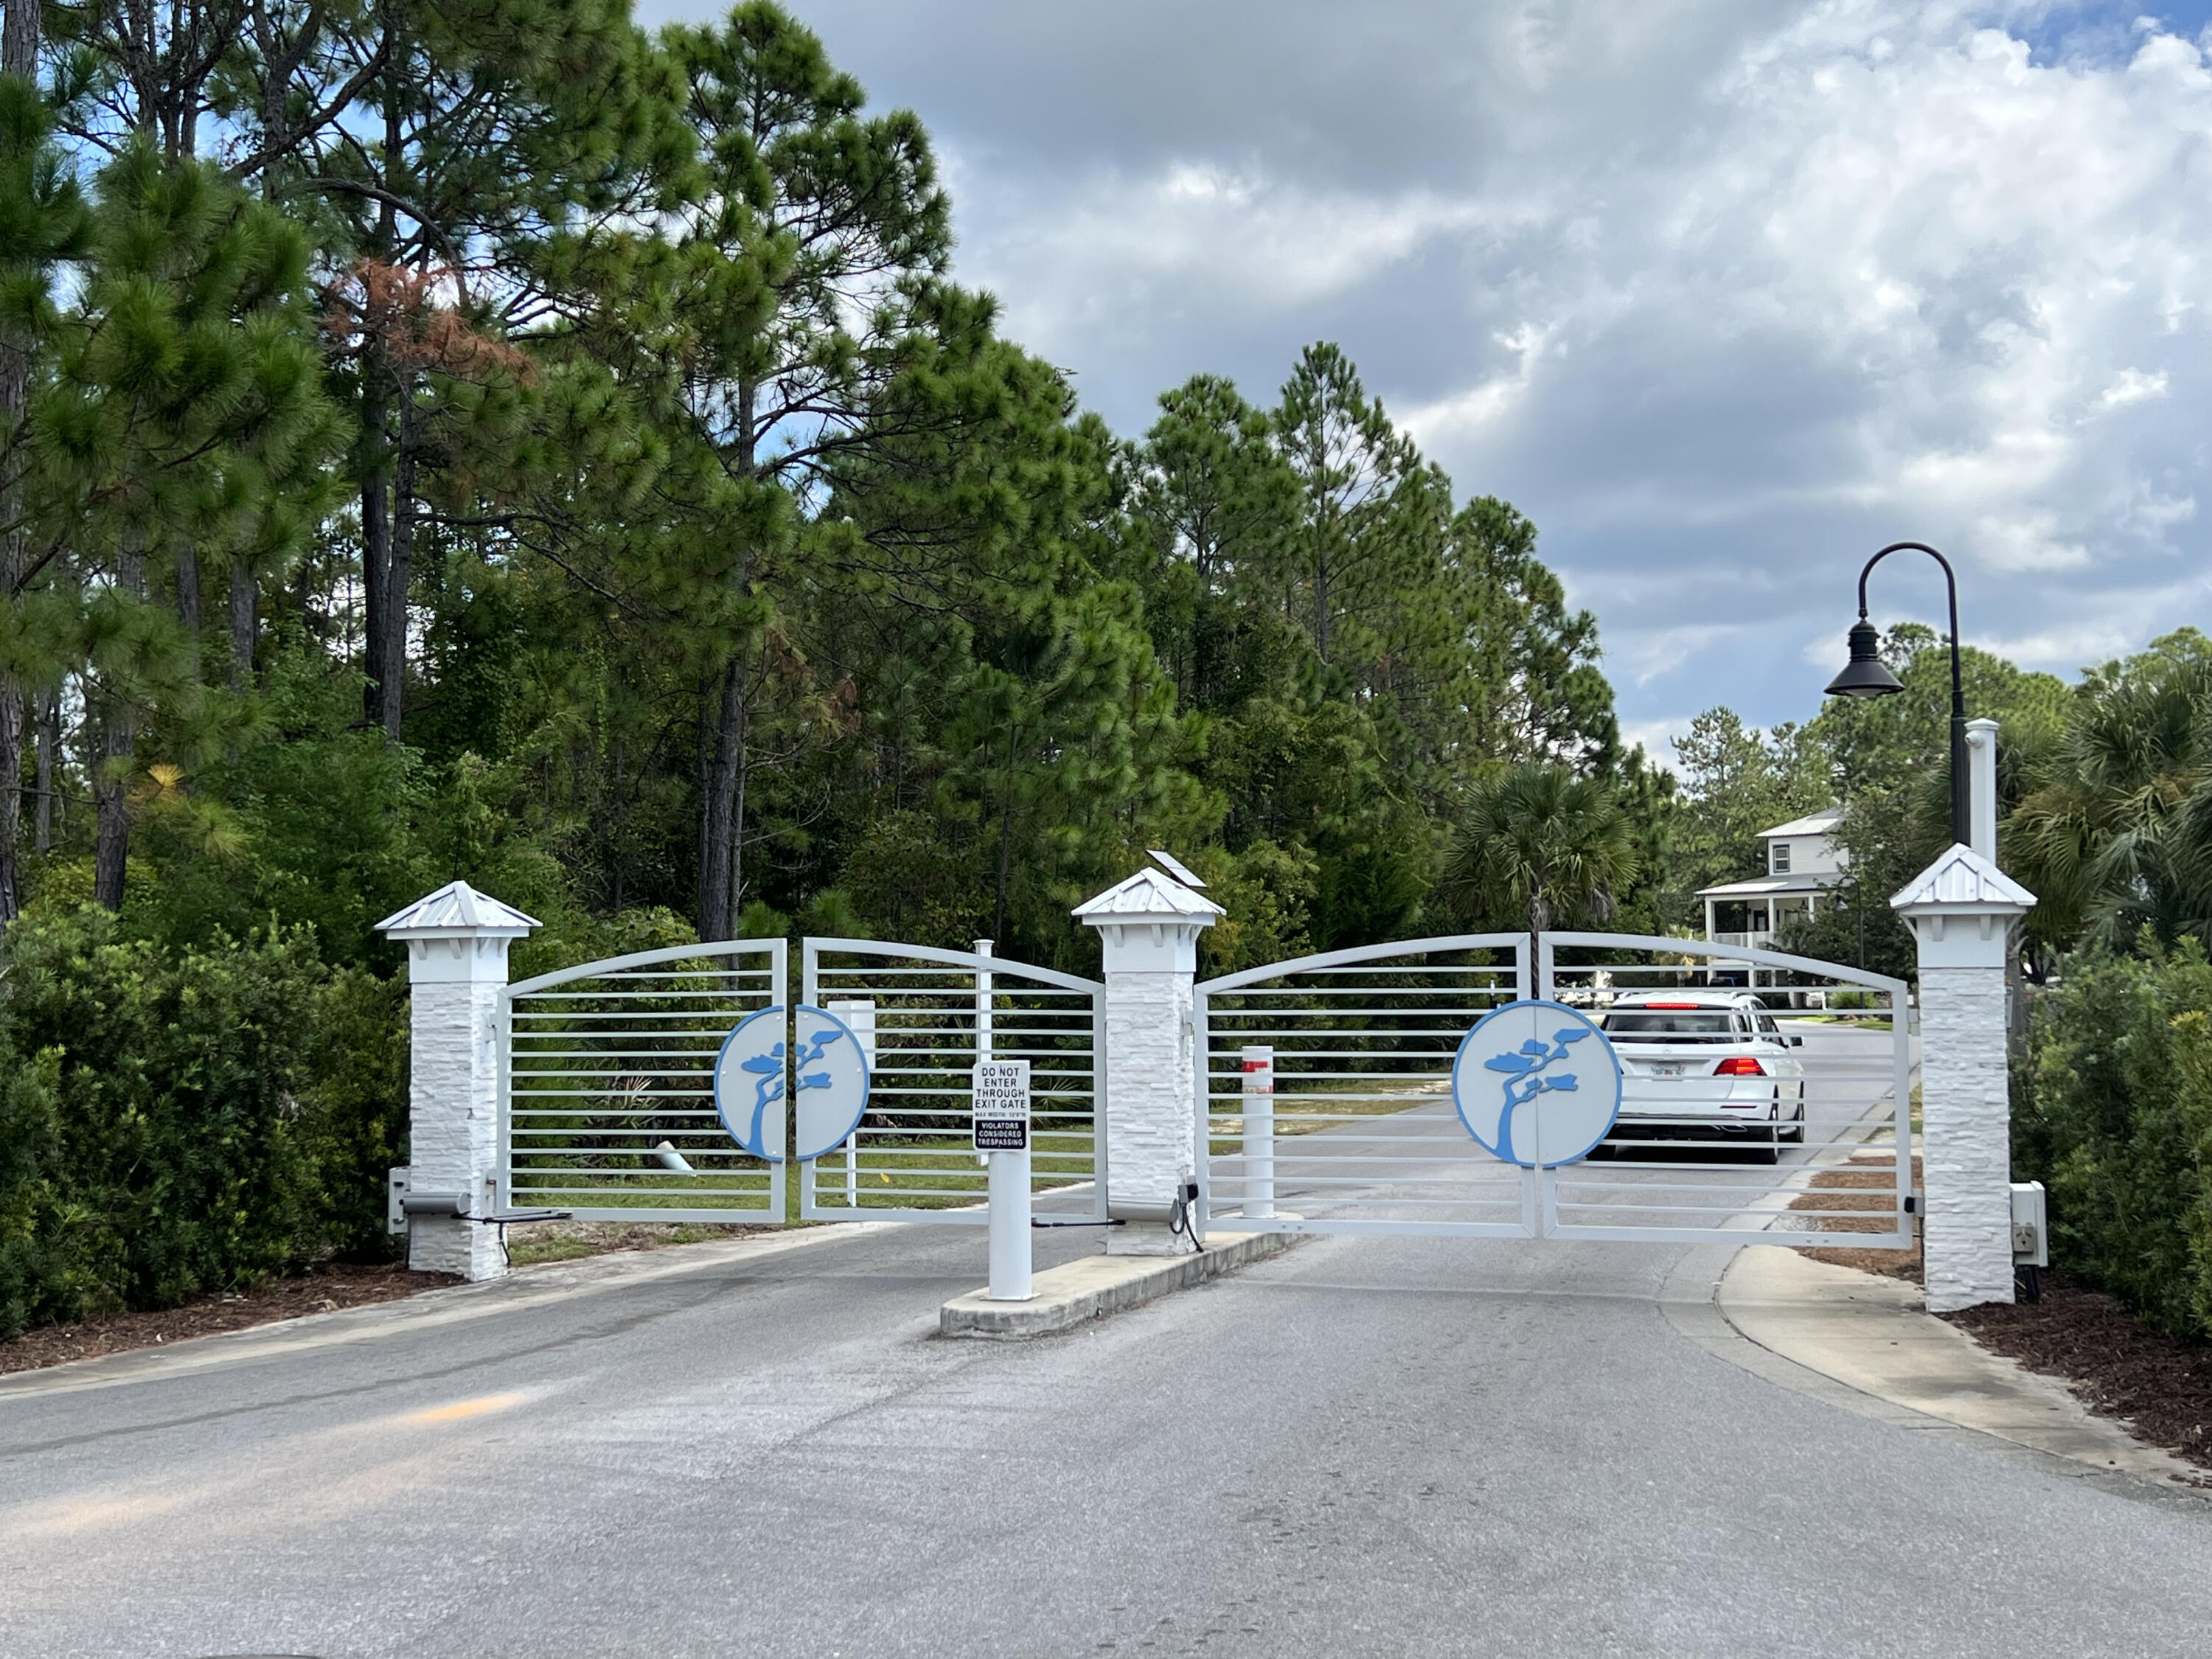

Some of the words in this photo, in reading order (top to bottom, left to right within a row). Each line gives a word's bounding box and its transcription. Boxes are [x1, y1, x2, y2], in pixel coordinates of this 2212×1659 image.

[981, 1068, 995, 1077] DO
[999, 1068, 1020, 1077] NOT
[984, 1078, 1017, 1087] ENTER
[976, 1088, 1025, 1098] THROUGH
[975, 1099, 997, 1108] EXIT
[1000, 1099, 1026, 1108] GATE
